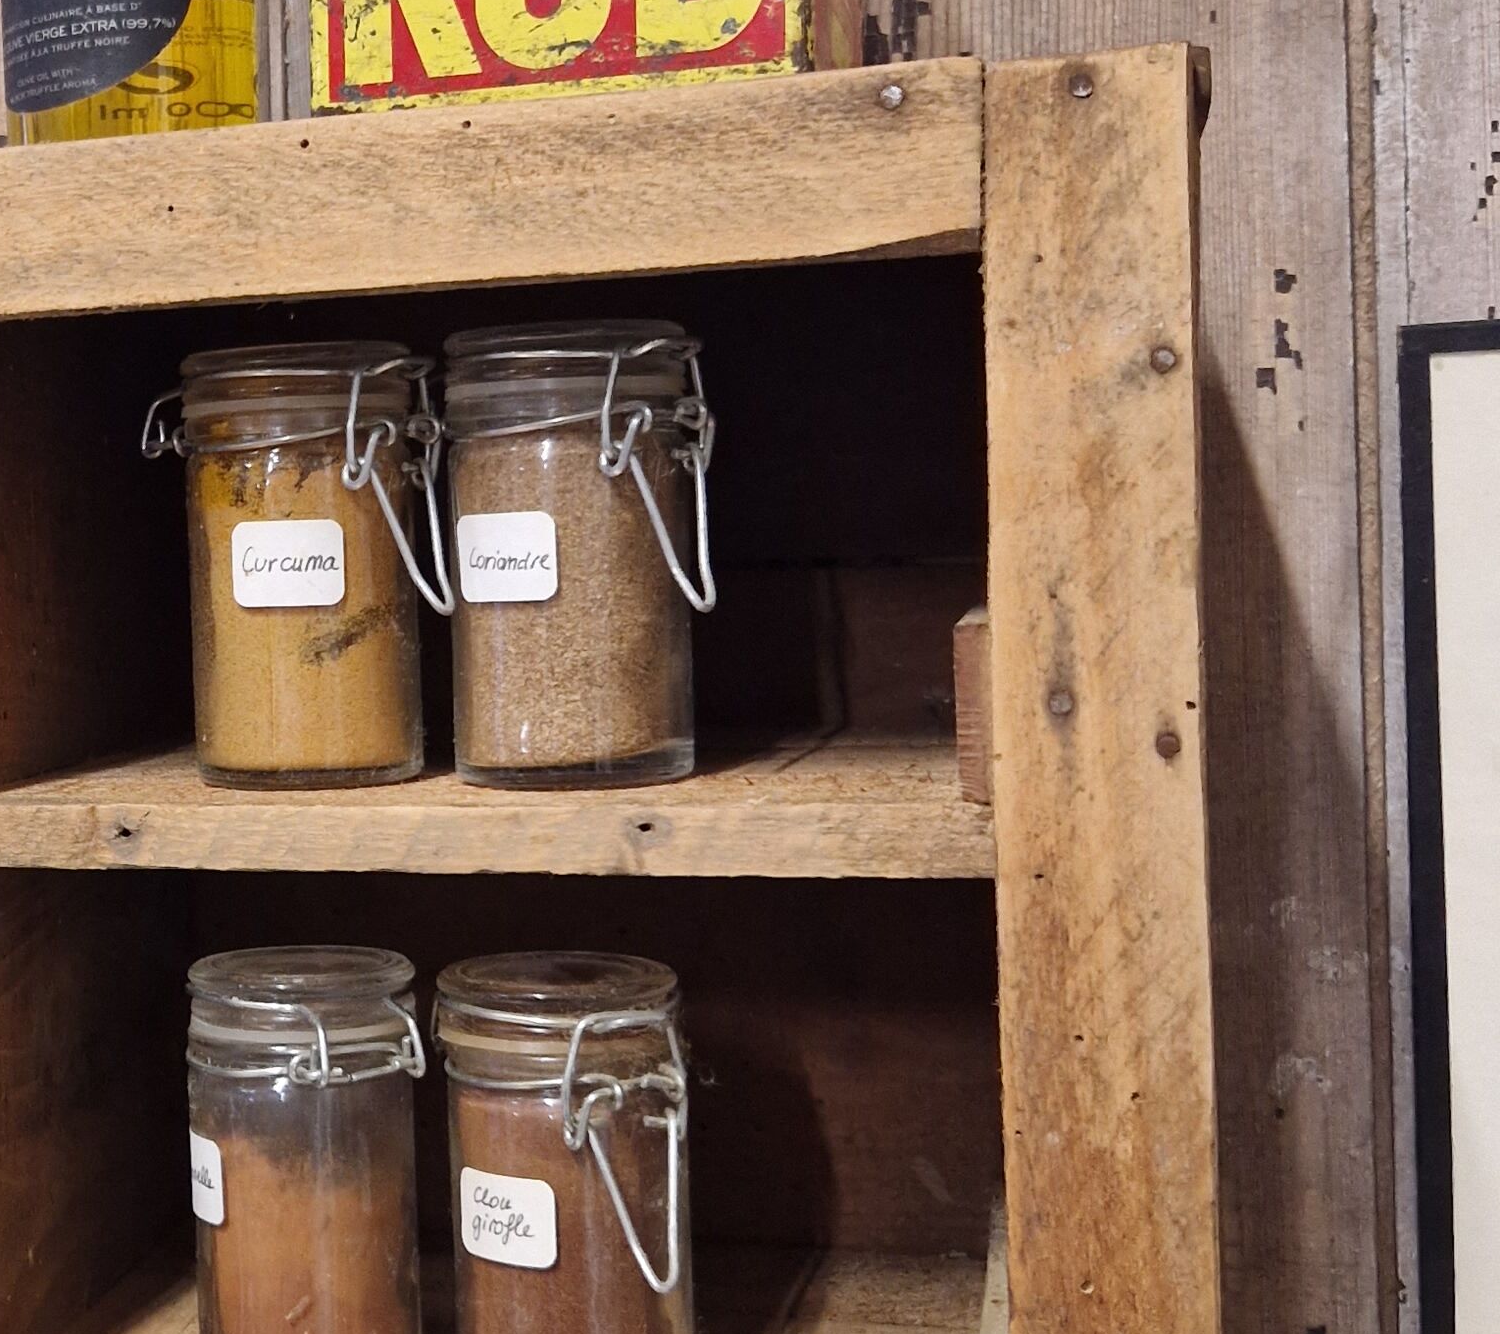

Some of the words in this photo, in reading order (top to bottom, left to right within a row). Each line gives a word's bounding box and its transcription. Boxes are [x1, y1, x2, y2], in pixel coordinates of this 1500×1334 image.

[32, 7, 83, 24] CULINAIRE
[96, 2, 127, 14] BASE
[25, 25, 67, 44] VIERGE
[70, 18, 119, 36] EXTRA
[121, 17, 177, 32] (99,7%)
[51, 39, 91, 55] TRUFFE
[94, 35, 131, 48] NOIRE
[242, 546, 340, 576] Curcuma
[469, 547, 550, 571] Coriandre
[472, 1213, 536, 1246] girofle
